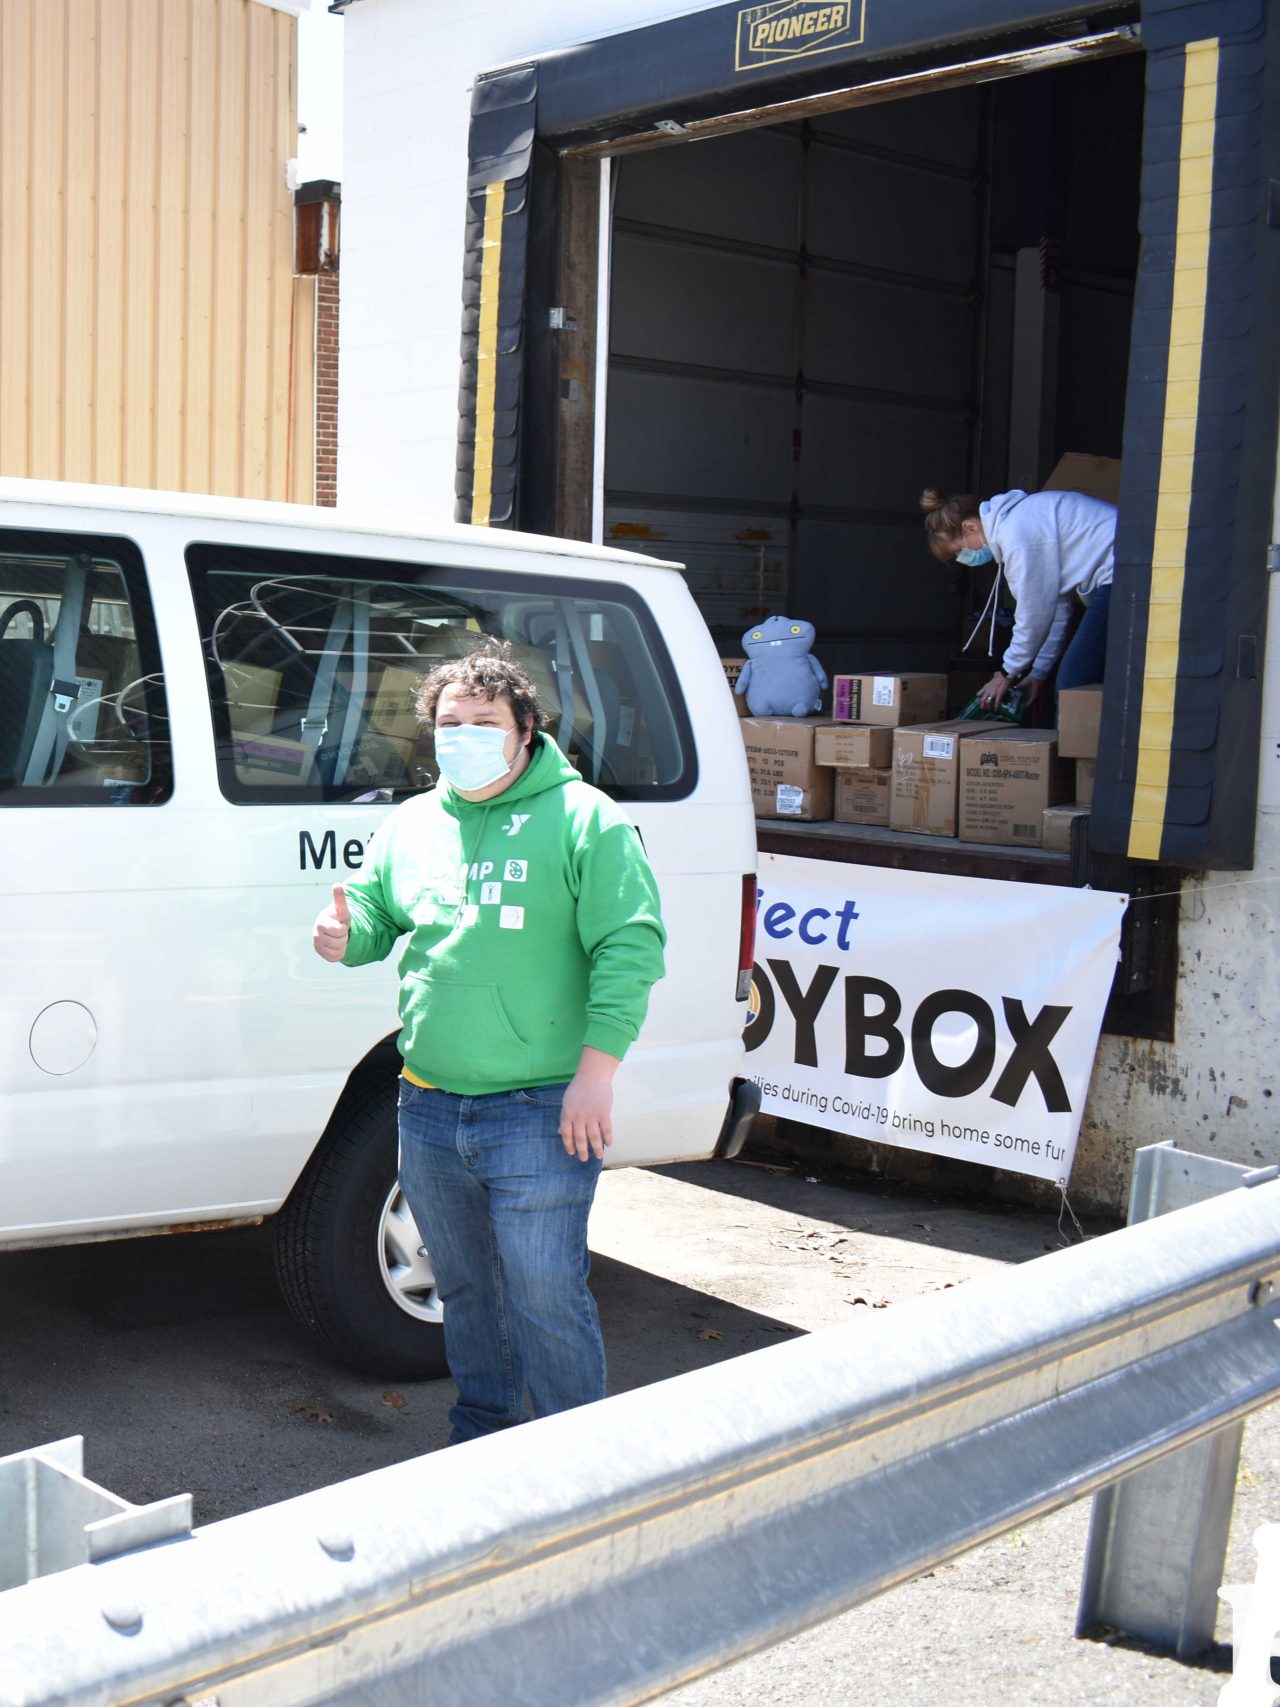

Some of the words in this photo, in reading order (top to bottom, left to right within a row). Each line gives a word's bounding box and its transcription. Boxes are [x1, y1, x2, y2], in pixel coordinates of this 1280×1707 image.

[754, 5, 845, 47] PIONEER
[781, 1084, 828, 1113] during
[831, 1096, 889, 1125] Covid-19
[891, 1110, 935, 1138] bring
[940, 1119, 990, 1144] home
[994, 1133, 1041, 1155] some
